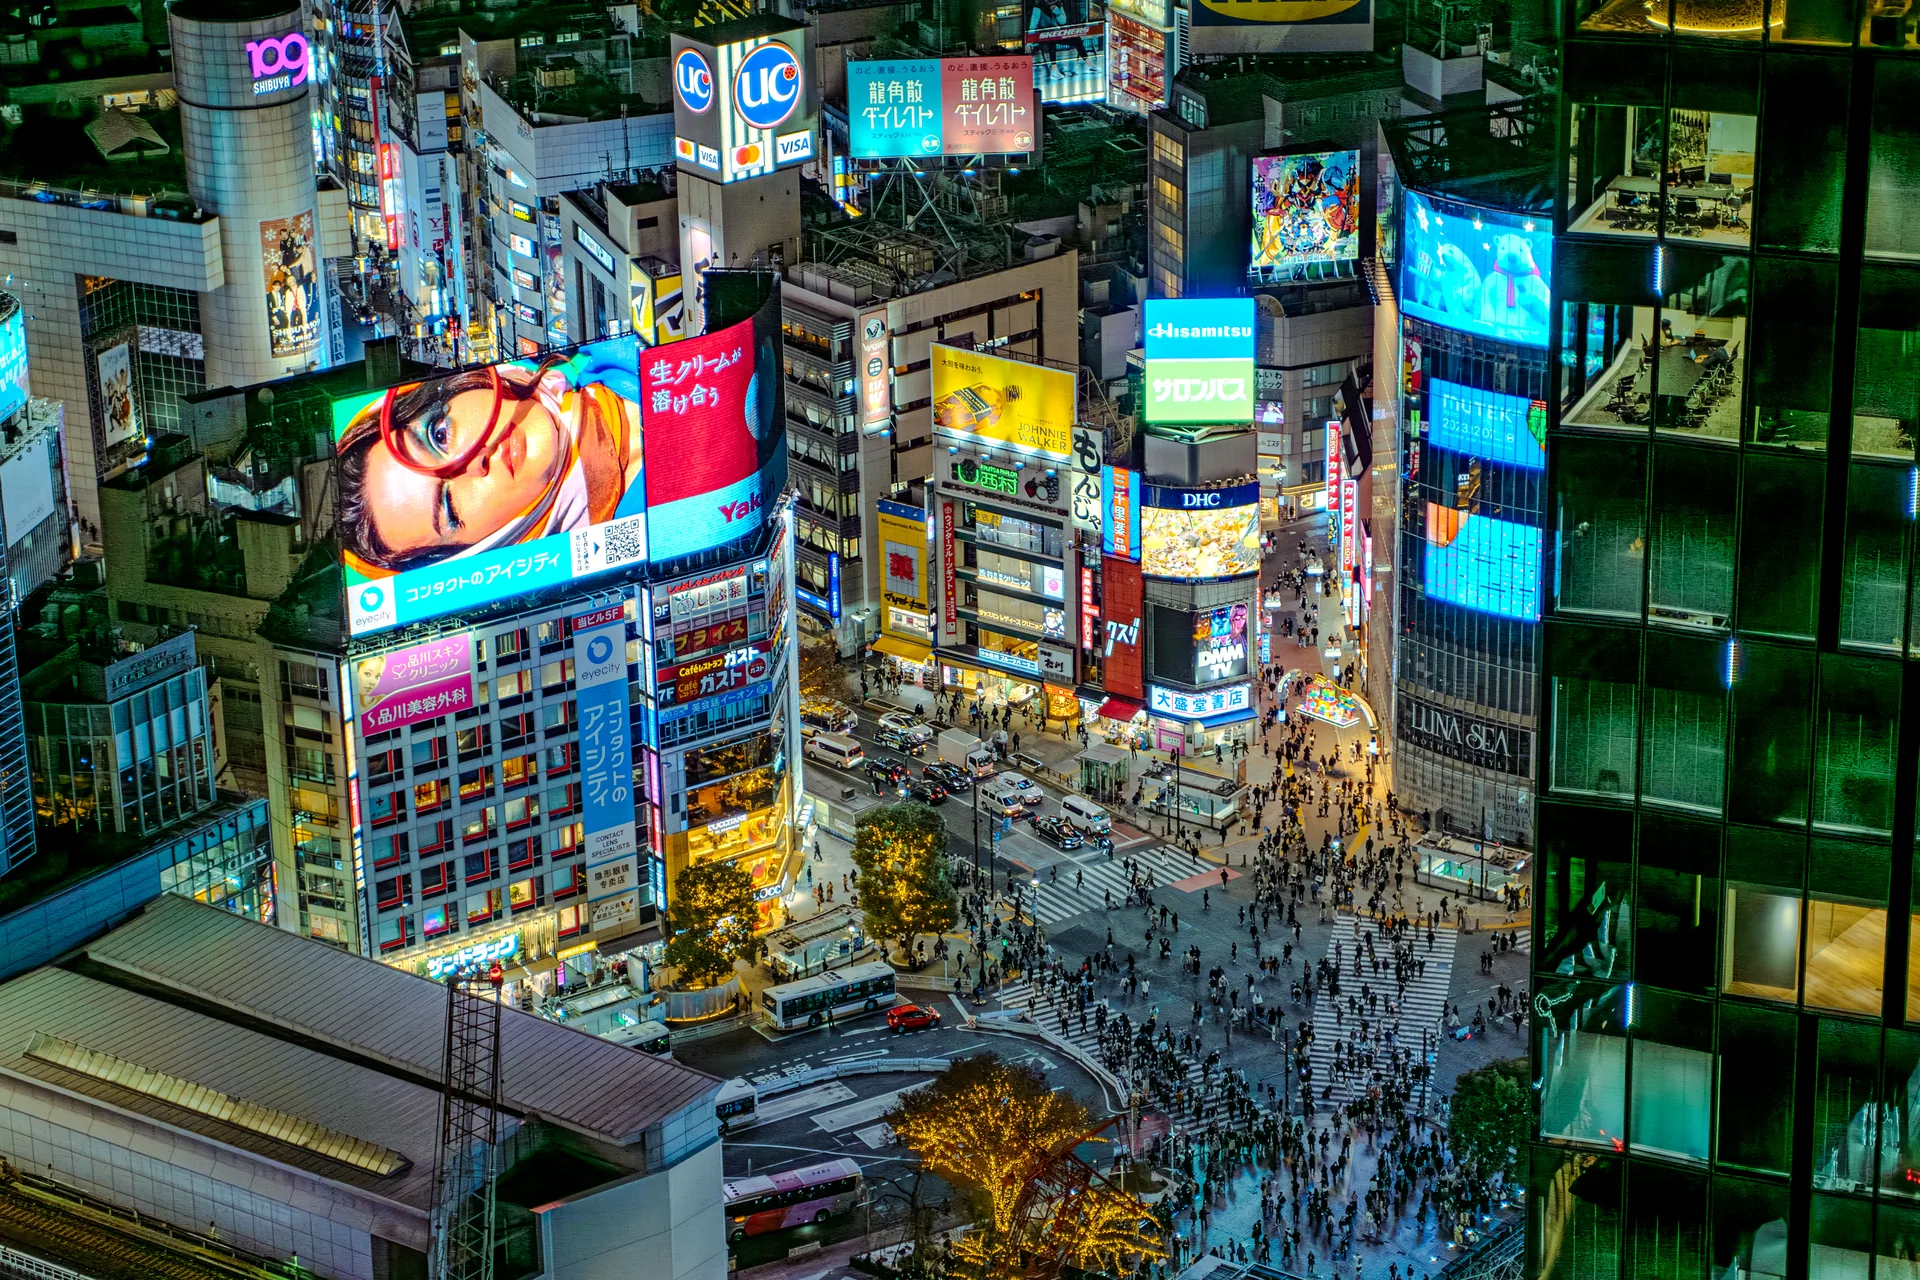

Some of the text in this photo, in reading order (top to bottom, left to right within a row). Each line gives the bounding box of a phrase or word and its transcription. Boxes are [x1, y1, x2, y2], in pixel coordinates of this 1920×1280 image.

[1039, 26, 1090, 41] SKECHERS
[245, 33, 308, 86] 109
[253, 75, 291, 95] SHIBUYA
[678, 62, 710, 99] UC
[741, 61, 797, 108] UC
[868, 79, 924, 105] 龍角散
[961, 76, 1016, 101] 龍角散
[861, 105, 934, 130] ダイレクト
[953, 102, 1026, 127] ダイレクト
[963, 129, 992, 137] スティック
[700, 151, 718, 165] VISA
[780, 137, 810, 156] VISA
[1147, 322, 1253, 339] Hisamitsu
[649, 350, 742, 386] 生クリームが
[651, 383, 719, 416] 溶け合う
[1152, 378, 1248, 403] サロンパス
[1017, 422, 1067, 441] JOHNNIE
[1017, 432, 1067, 451] WALKER
[981, 472, 1018, 495] 西村
[1072, 429, 1102, 532] もんじゃ
[1328, 461, 1338, 505] カラオケ
[1183, 492, 1221, 507] DHC
[1344, 486, 1354, 532] カラオケ
[1113, 472, 1127, 554] 三千里薬品
[944, 514, 954, 590] ウィンターフルーツギフト
[405, 548, 561, 604] コンタクトのアイシティ
[889, 552, 915, 581] 薬
[667, 566, 747, 595] しゃぶしゃぶバイキング
[697, 581, 742, 607] しゃぶ葉
[355, 610, 392, 628] eyecity
[577, 607, 620, 630] 当ビル5F
[654, 604, 670, 618] 9F
[407, 643, 464, 668] 品川スキン
[723, 646, 760, 669] ガスト
[1198, 643, 1245, 668] DMM
[408, 658, 459, 681] クリニック
[581, 663, 621, 681] eyecity
[700, 668, 743, 695] ガスト
[1210, 661, 1233, 680] TV
[658, 686, 675, 702] 7F
[678, 680, 698, 693] Café
[377, 686, 468, 725] 品川美容外科
[1157, 690, 1243, 712] 大盛堂書店
[1411, 702, 1512, 758] LUNA SEA
[583, 703, 609, 807] アイシティ
[608, 699, 628, 804] コンタクトの
[1497, 803, 1529, 815] TSUTAYA
[595, 829, 625, 844] CONTACT
[602, 838, 619, 849] LENS
[591, 841, 631, 859] SPECIALISTS
[594, 863, 630, 882] 隐形眼镜
[600, 875, 626, 890] 专卖店
